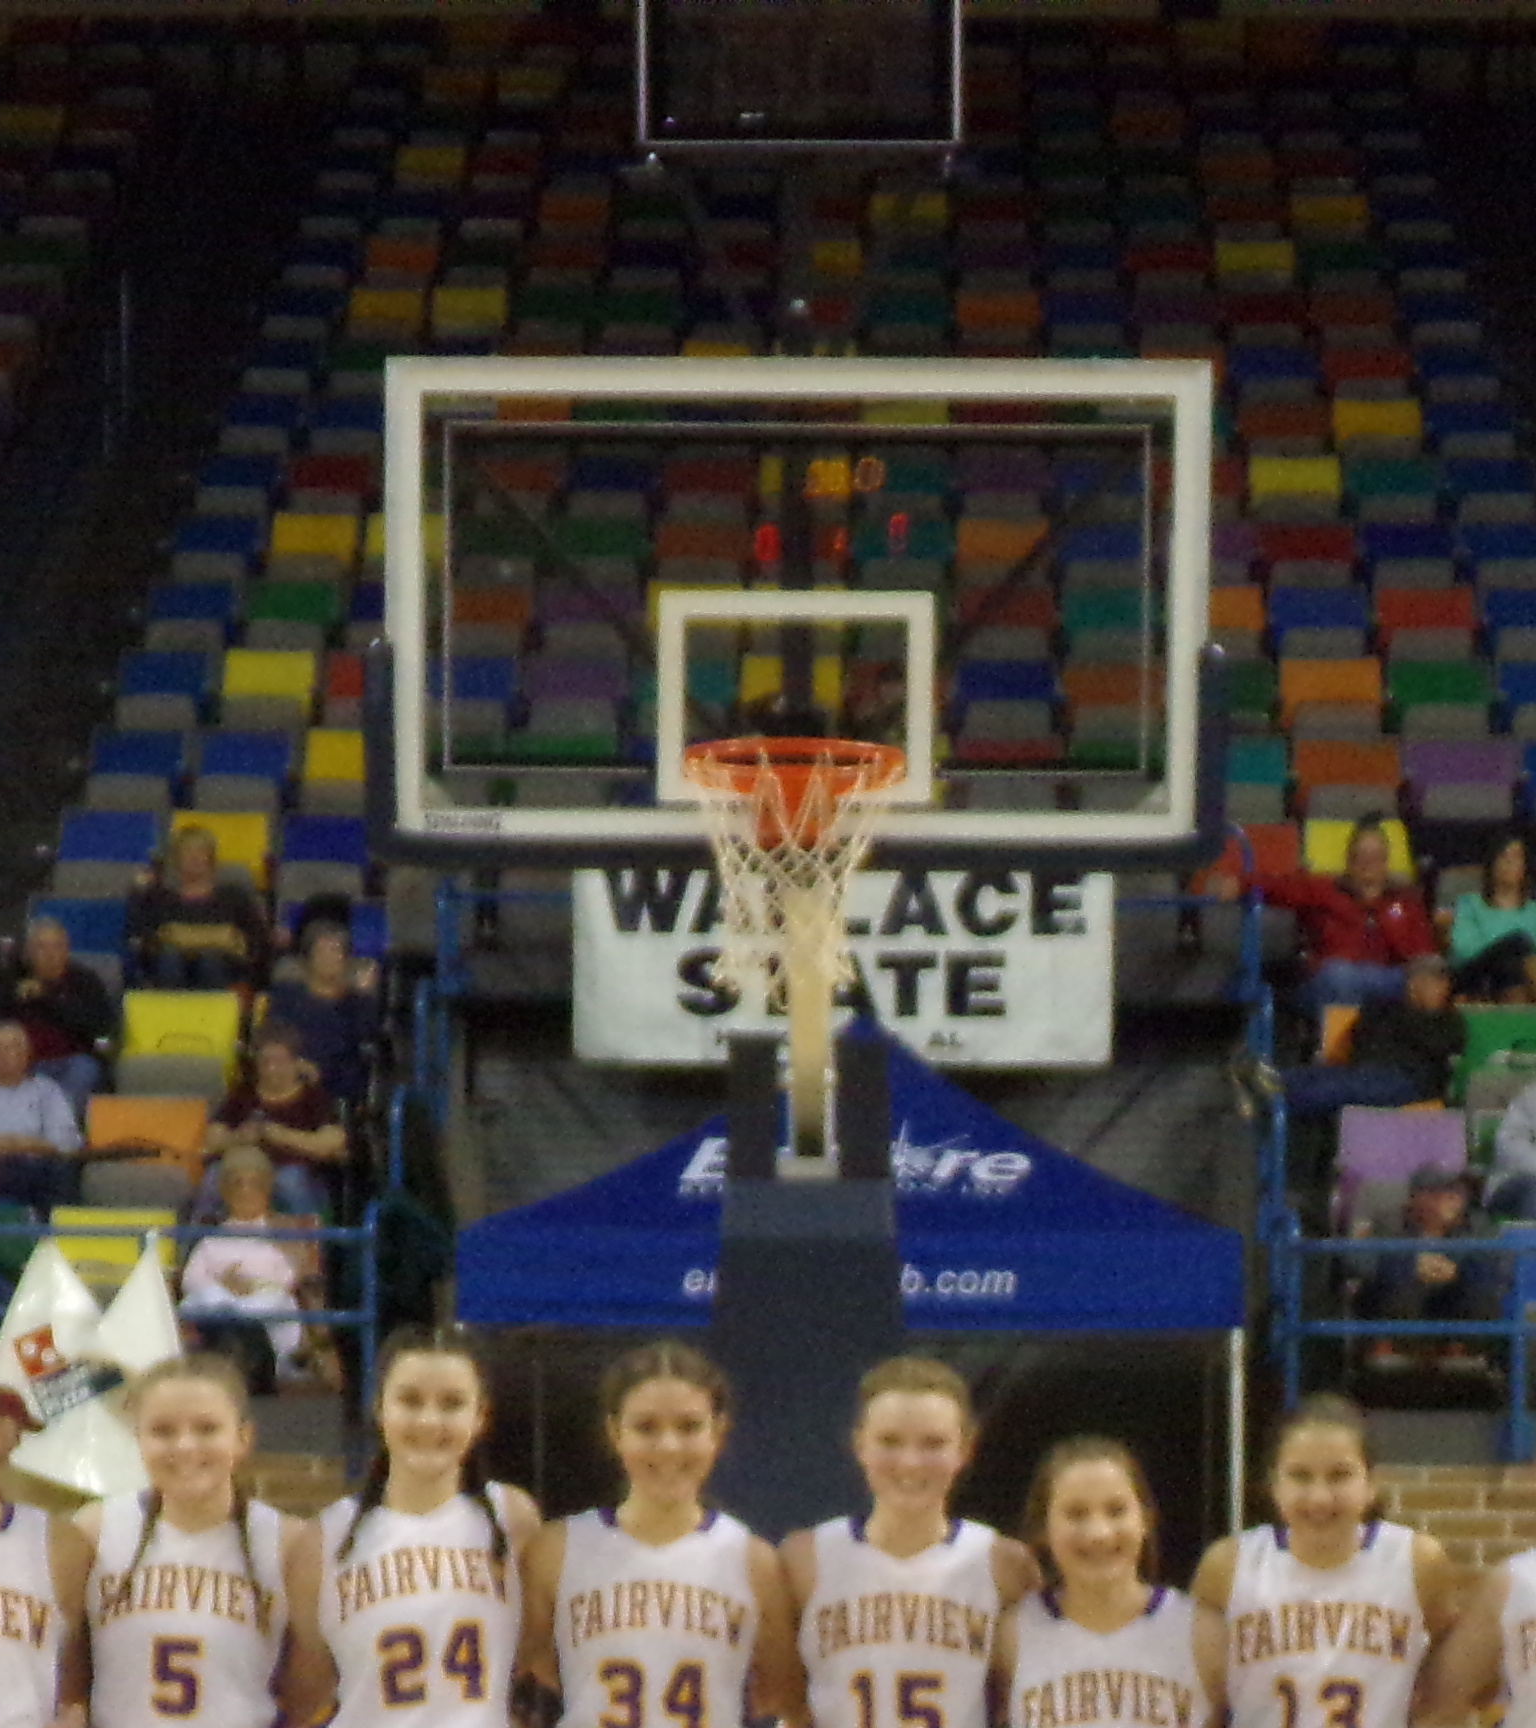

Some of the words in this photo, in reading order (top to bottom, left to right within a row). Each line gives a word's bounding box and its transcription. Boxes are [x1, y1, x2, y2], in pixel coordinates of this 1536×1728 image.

[676, 945, 1007, 1018] SATE
[570, 1579, 746, 1648] FAIRVIEW
[818, 1590, 990, 1659] FAIRVIEW
[1234, 1600, 1411, 1666] FAIRVIEW
[149, 1634, 205, 1719] 5
[376, 1618, 491, 1710] 24
